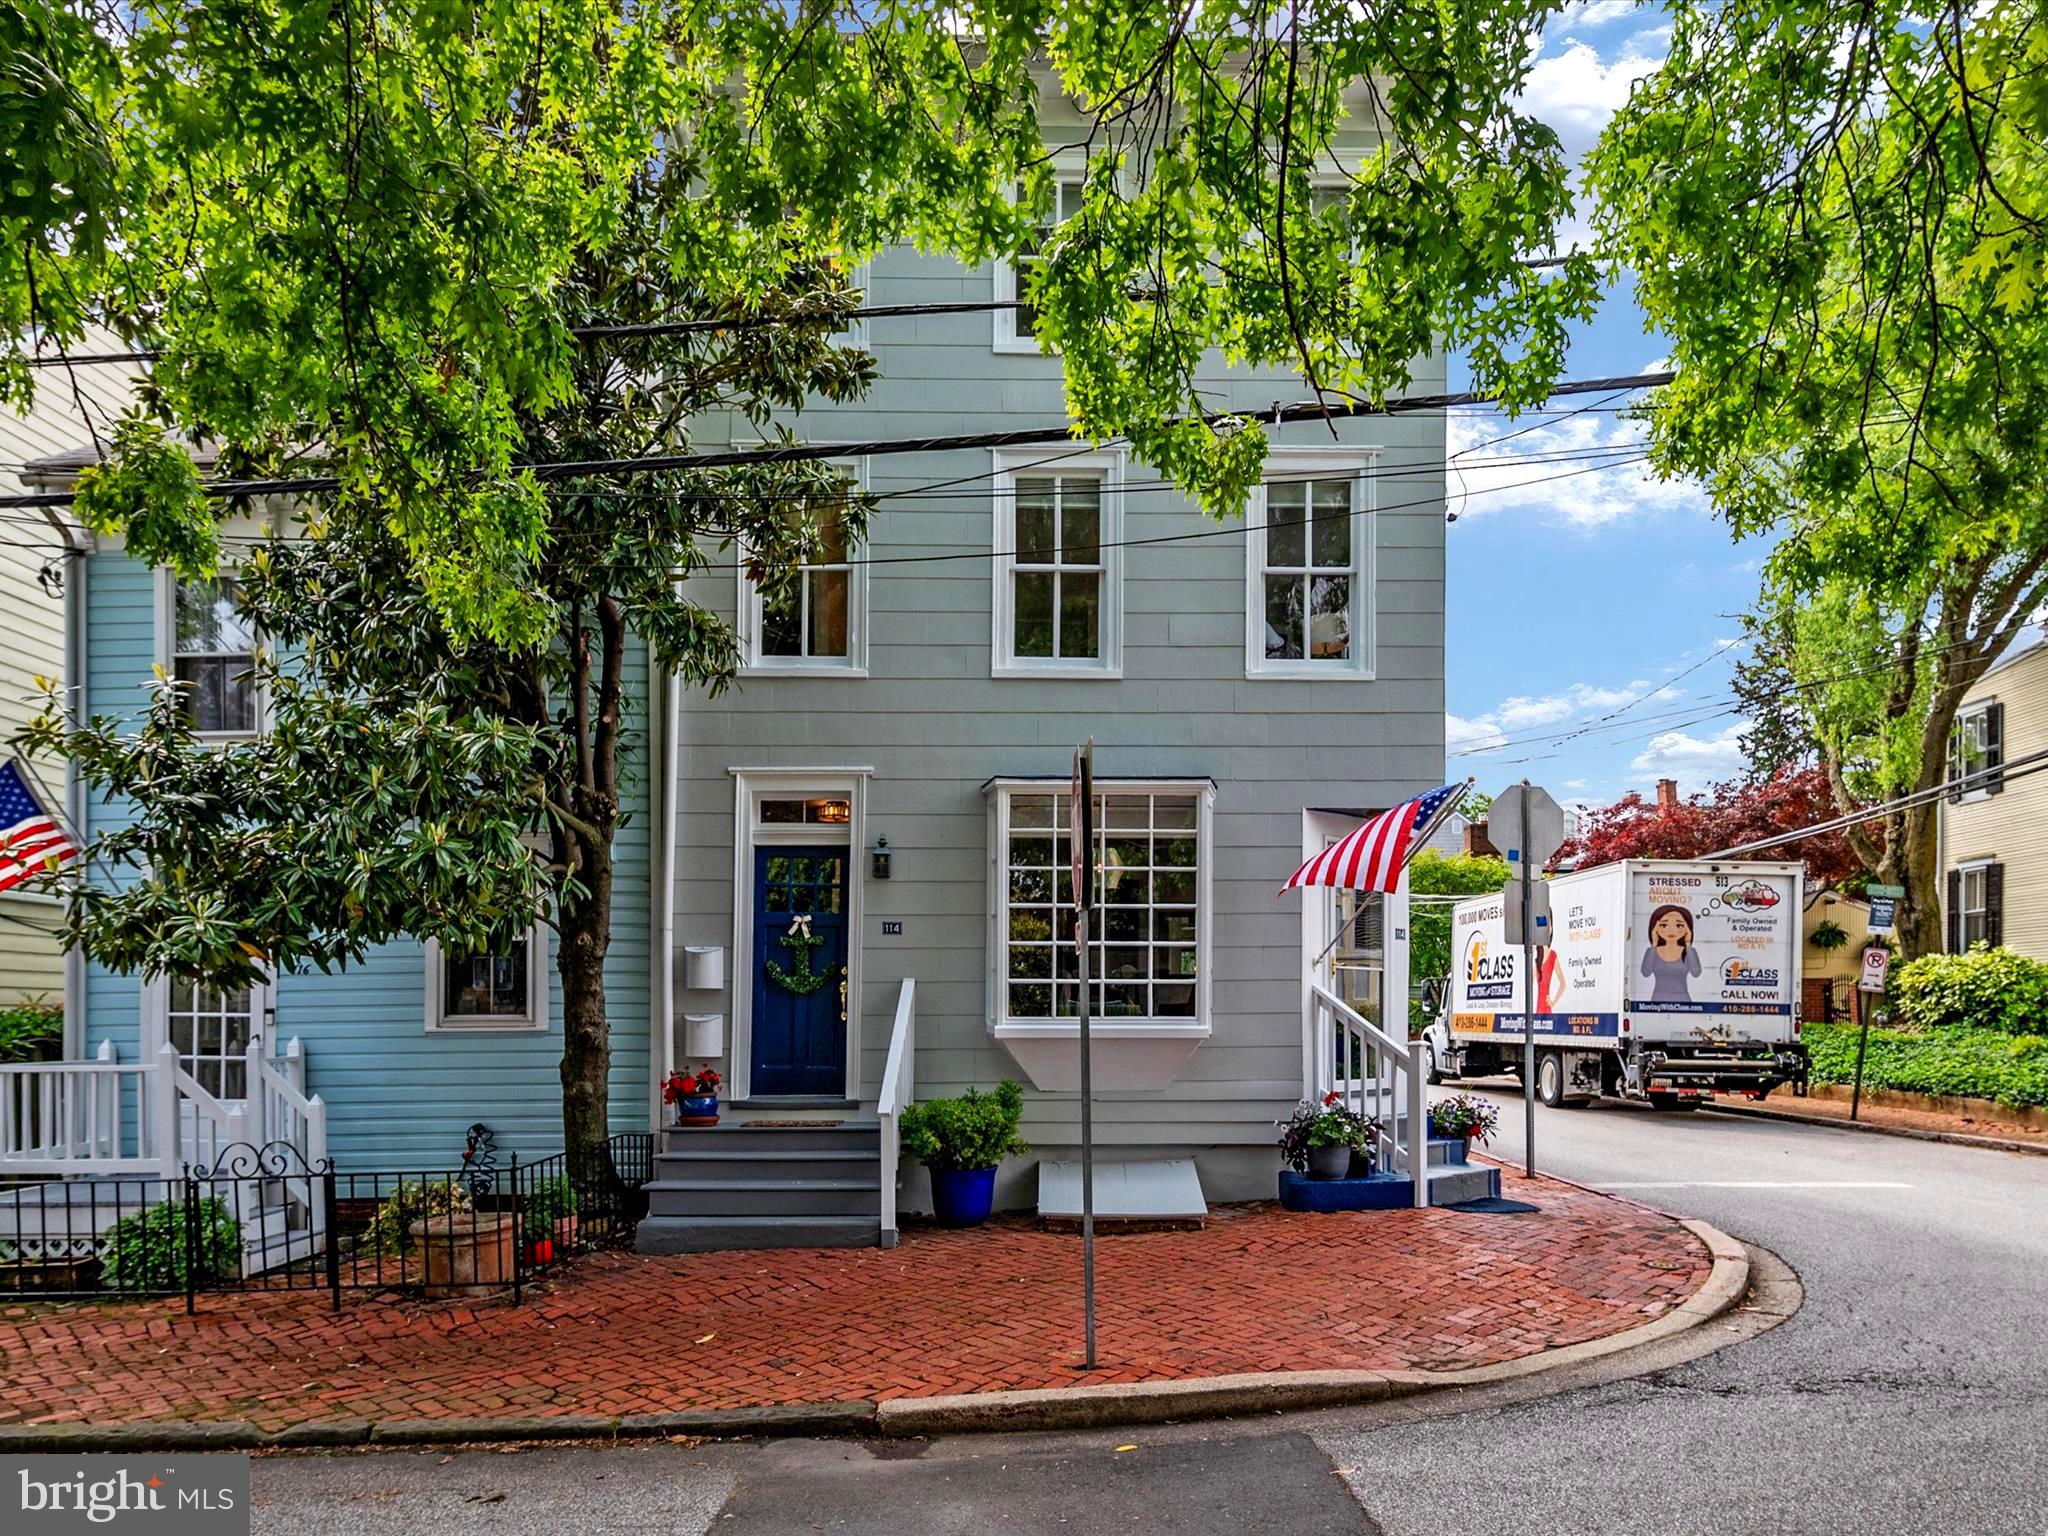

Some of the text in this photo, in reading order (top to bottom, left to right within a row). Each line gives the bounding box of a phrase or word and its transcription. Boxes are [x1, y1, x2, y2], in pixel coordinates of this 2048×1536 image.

[1648, 877, 1702, 887] STRESSED
[1716, 876, 1729, 888] 513
[1648, 887, 1682, 895] ABOUT
[1648, 895, 1693, 904] MOVING?
[1478, 906, 1498, 922] MOVES
[1568, 905, 1583, 918] LET'S
[1568, 916, 1597, 930] MOVE YOU
[1727, 917, 1778, 926] Family Owned
[885, 923, 900, 933] 114
[1739, 925, 1773, 933] Operated
[1731, 936, 1774, 944] LOCATED IN
[1478, 954, 1514, 980] CLASS
[1568, 956, 1602, 968] Family Owned
[1582, 968, 1587, 978] &
[1740, 968, 1779, 979] CLASS
[1573, 978, 1596, 990] Operated
[1721, 990, 1779, 1001] CALL NOW!
[1639, 1002, 1780, 1013] MovingWithClass.com 410-286-1444
[1500, 1016, 1553, 1032] MovingWiass.com
[1568, 1016, 1593, 1025] LOCATIONS
